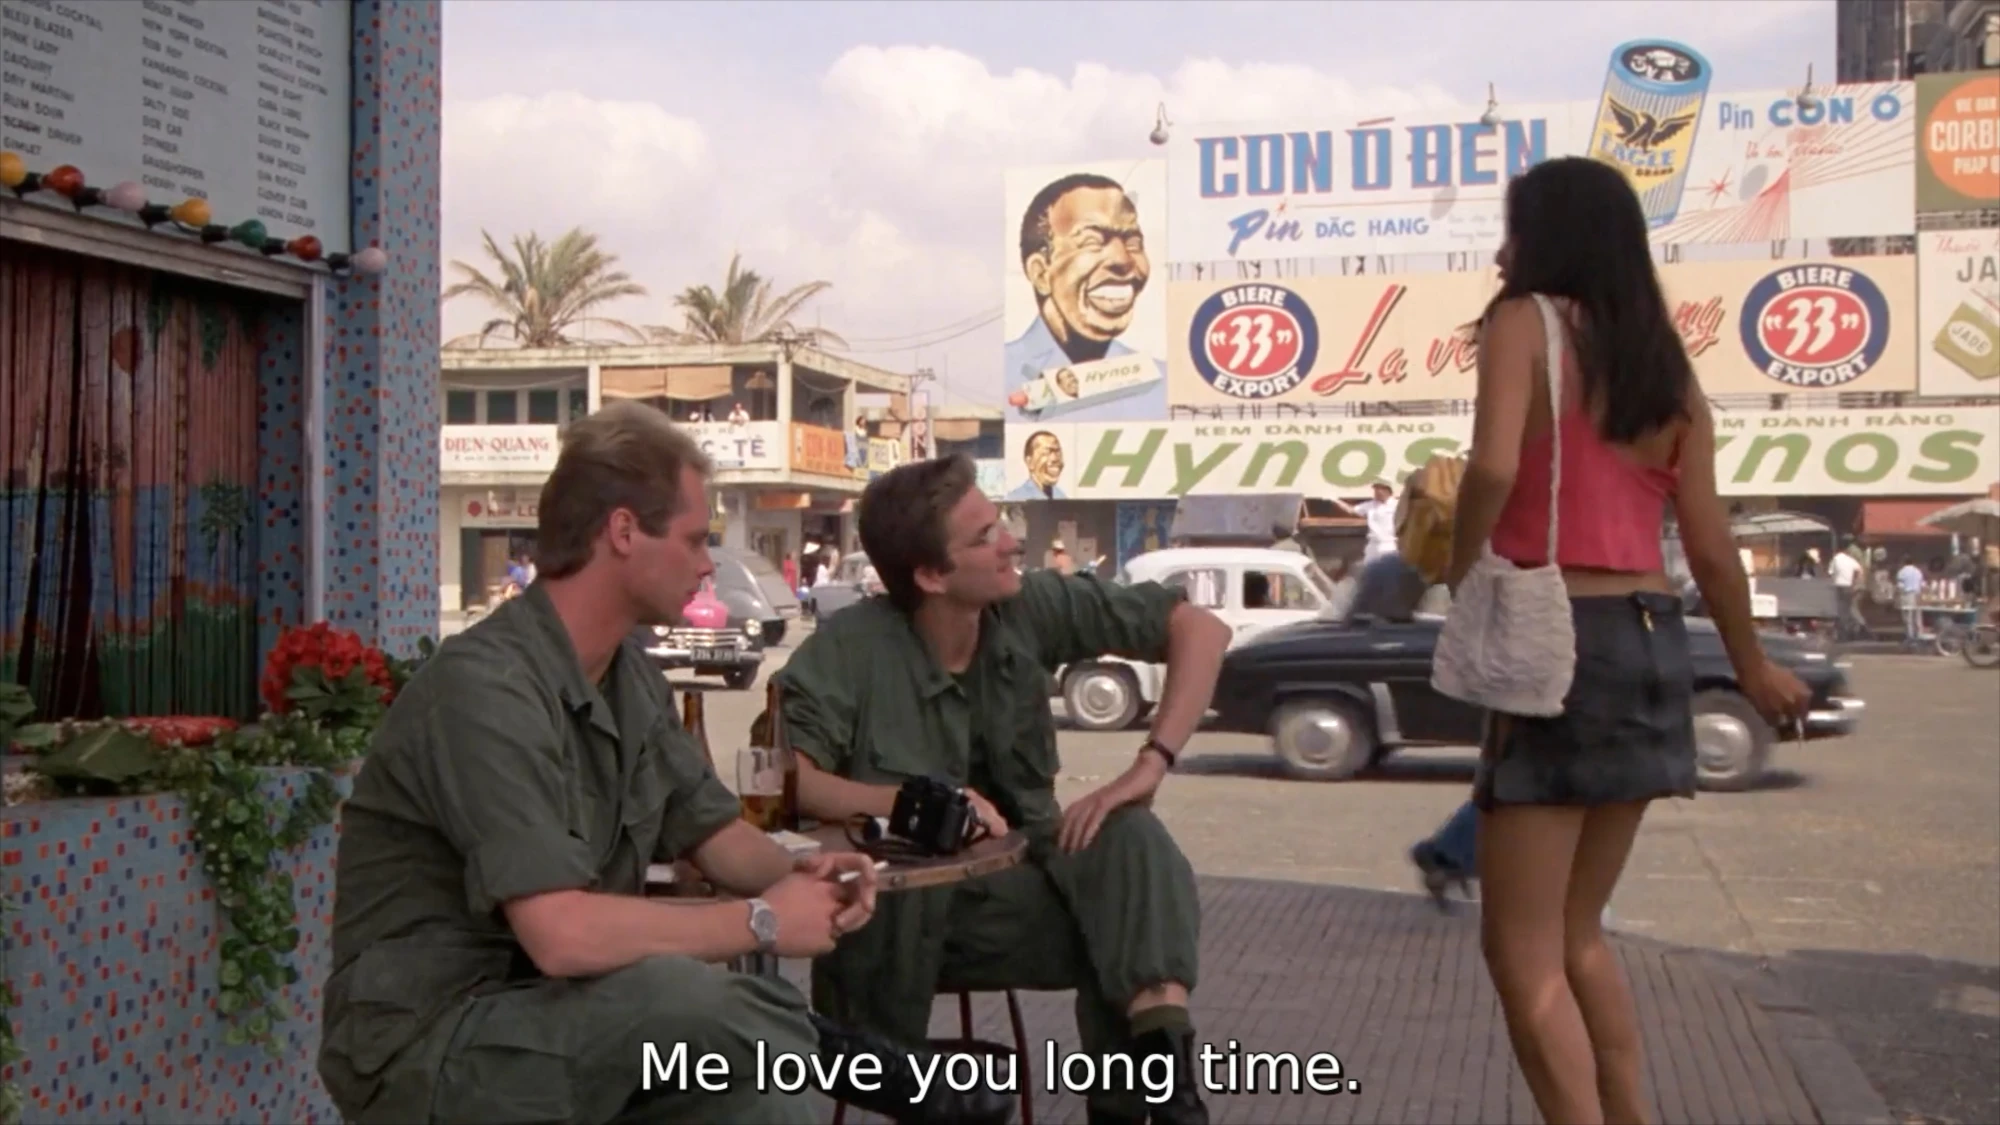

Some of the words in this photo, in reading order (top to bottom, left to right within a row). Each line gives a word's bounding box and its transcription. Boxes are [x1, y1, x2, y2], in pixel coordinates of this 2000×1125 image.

[1720, 102, 1753, 130] Pin
[1768, 98, 1853, 127] CON
[1194, 130, 1333, 198] CON
[1227, 203, 1303, 257] Pin
[1777, 266, 1853, 290] BIERE
[1221, 287, 1286, 308] BIERE
[1311, 284, 1408, 396] La
[1952, 326, 1989, 354] JADE
[1213, 366, 1301, 397] EXPORT
[1767, 353, 1867, 386] EXPORT
[1716, 430, 1985, 483] nos
